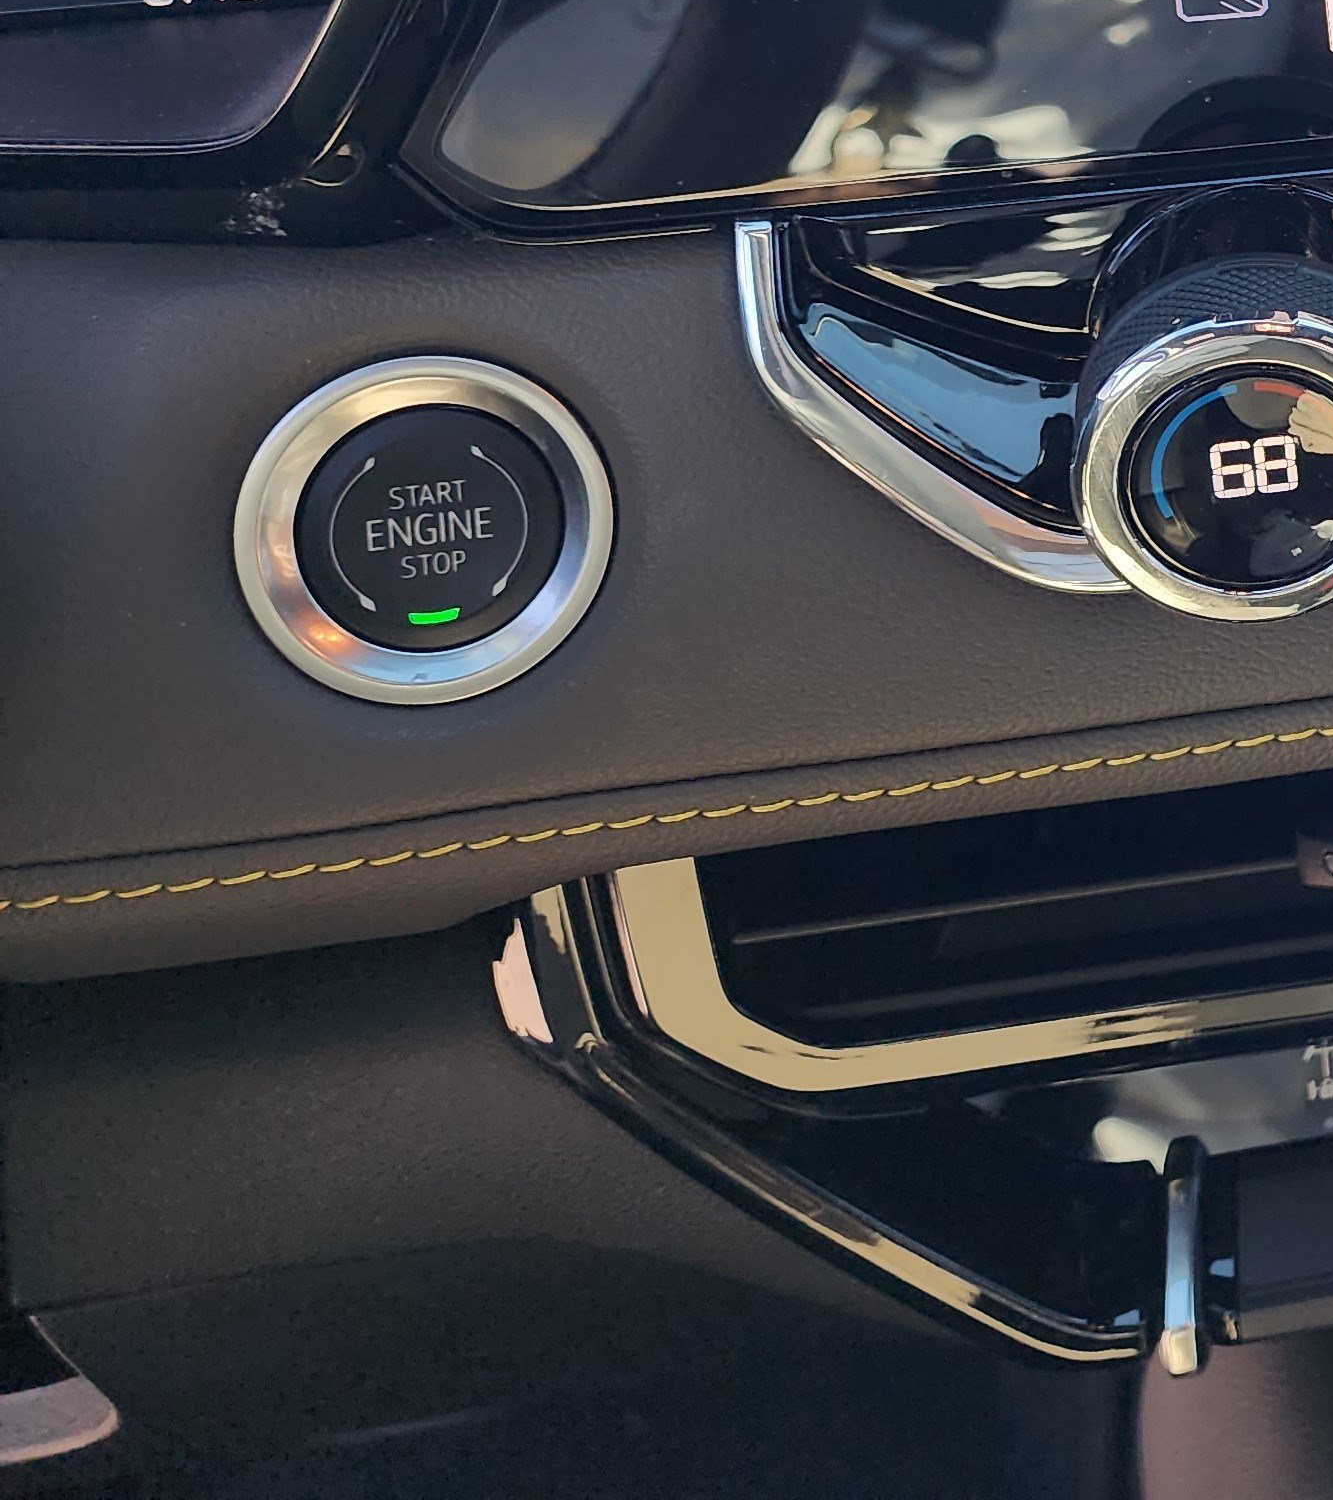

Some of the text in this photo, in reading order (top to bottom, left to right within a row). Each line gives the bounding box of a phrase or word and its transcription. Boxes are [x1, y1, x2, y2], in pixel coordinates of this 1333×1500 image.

[1209, 434, 1300, 499] 68
[389, 479, 467, 511] START
[365, 507, 494, 552] ENGINE
[400, 549, 467, 579] STOP
